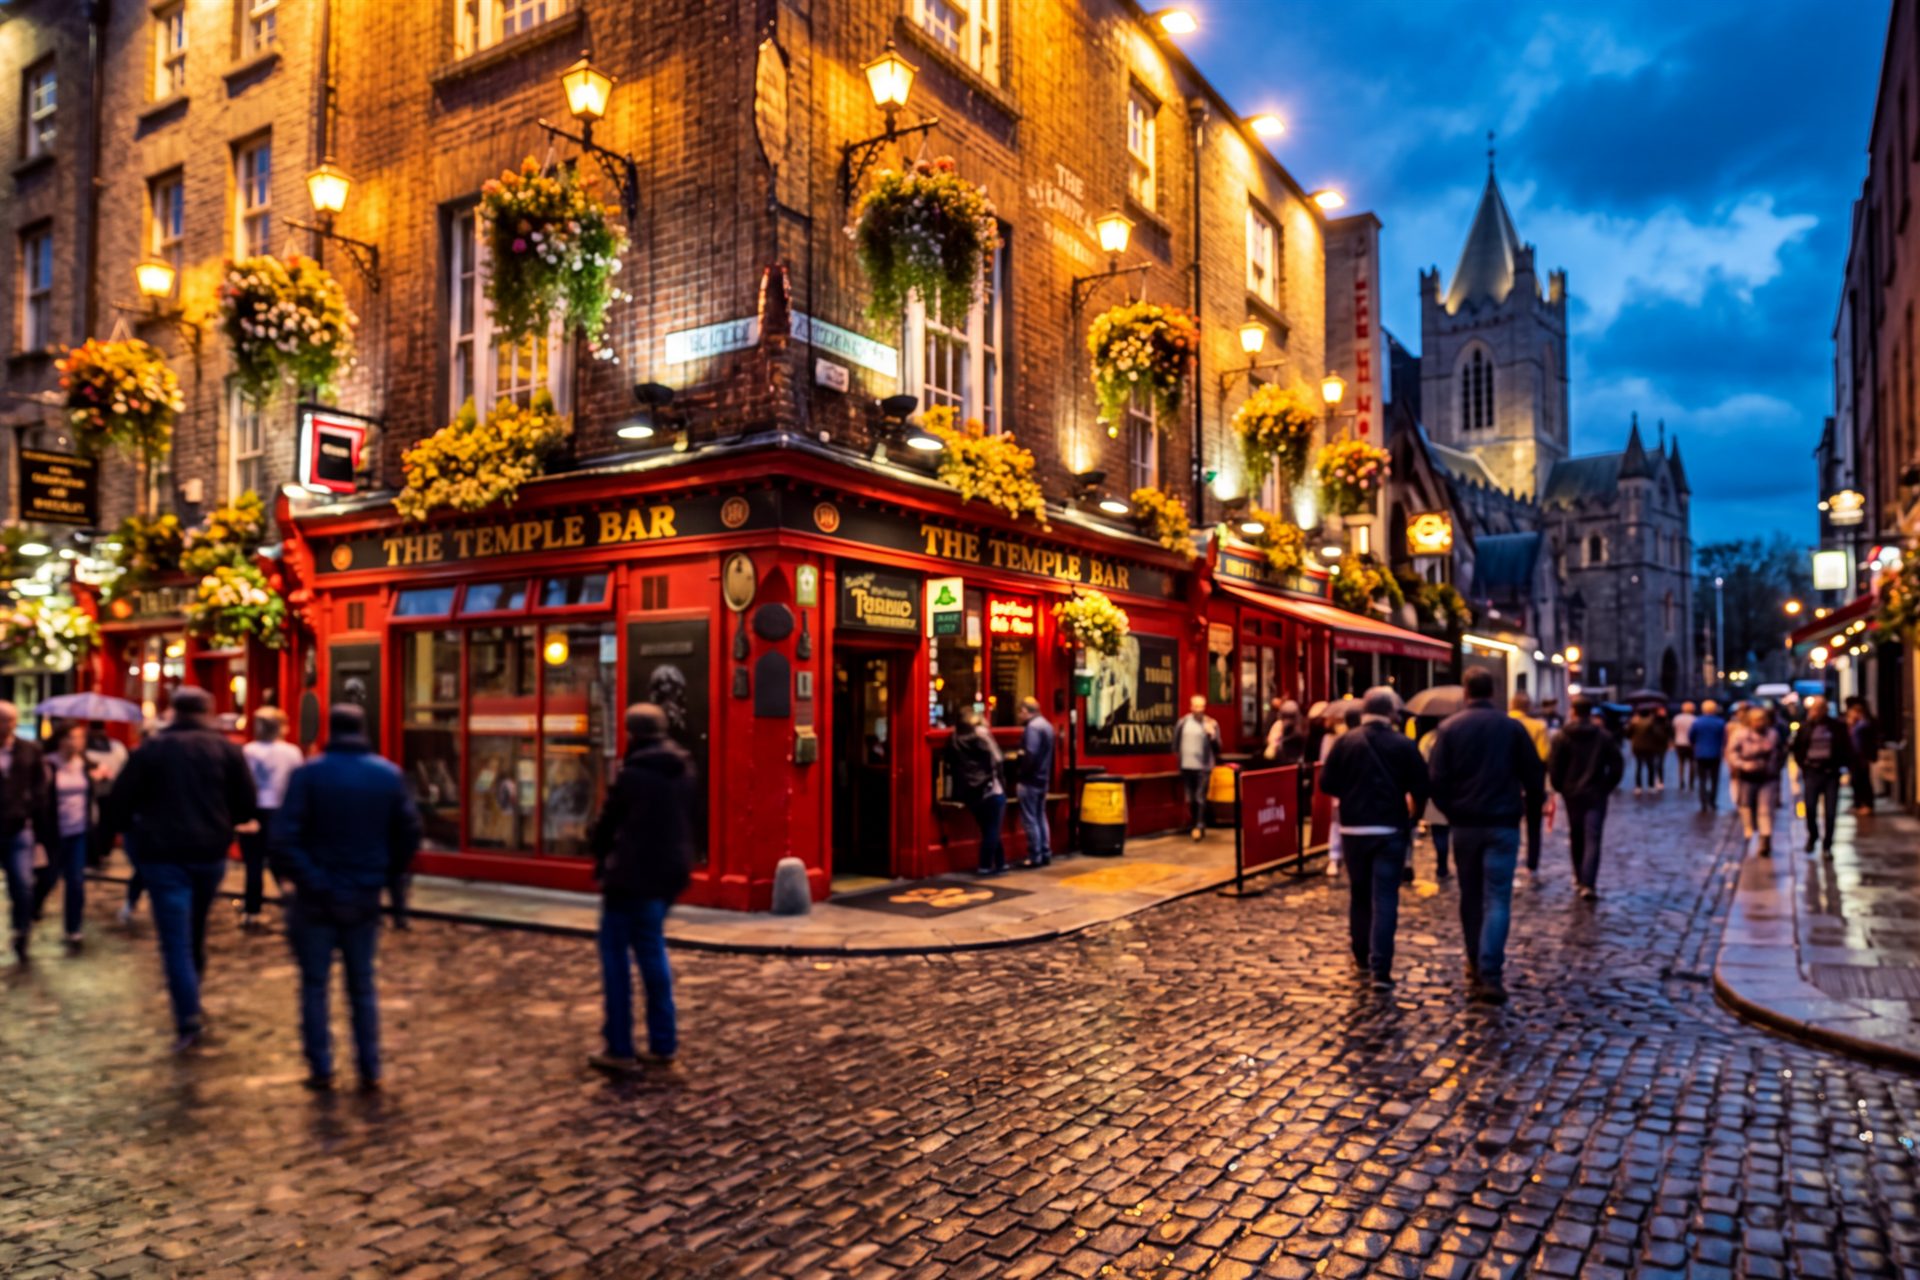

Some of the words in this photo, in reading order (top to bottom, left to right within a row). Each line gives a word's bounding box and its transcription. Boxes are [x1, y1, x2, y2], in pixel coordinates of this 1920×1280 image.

[1055, 163, 1085, 200] THE
[383, 533, 443, 566] THE
[454, 515, 585, 558] TEMPLE
[598, 505, 677, 543] BAR
[921, 524, 981, 562] THE
[989, 539, 1081, 582] TEMPLE
[1089, 559, 1129, 589] BAR
